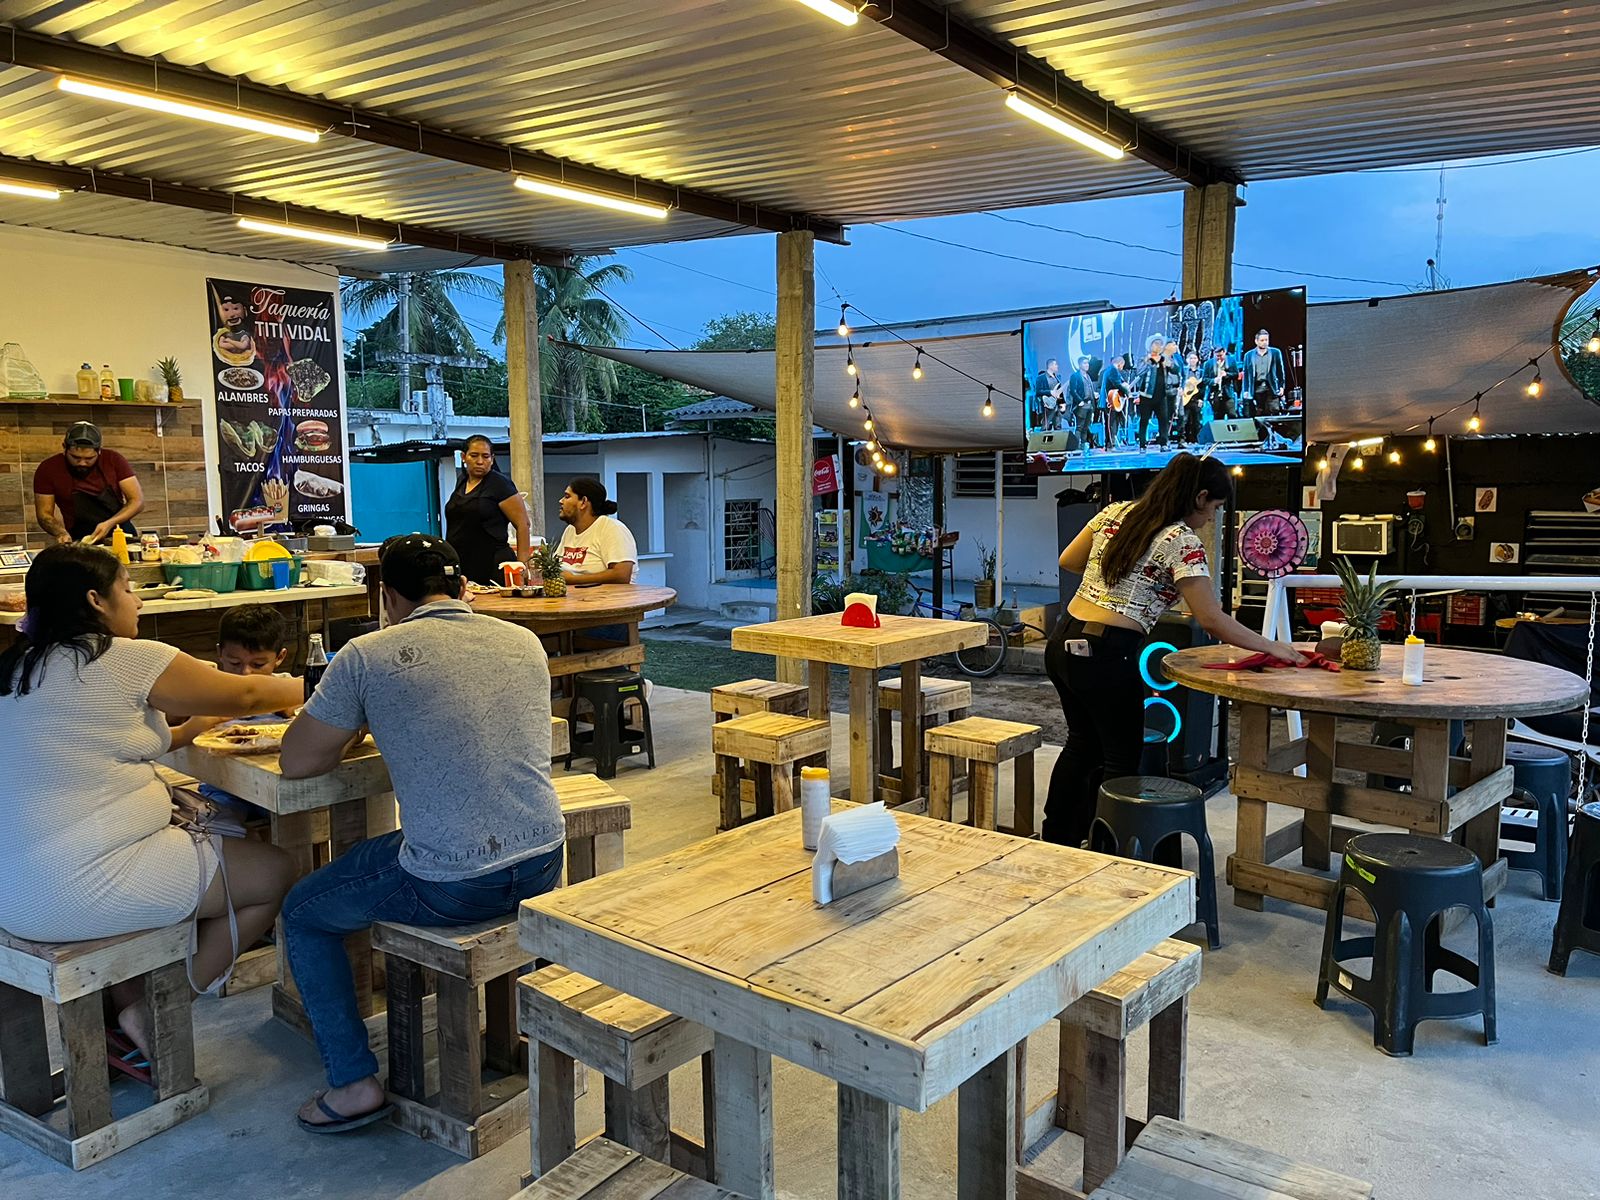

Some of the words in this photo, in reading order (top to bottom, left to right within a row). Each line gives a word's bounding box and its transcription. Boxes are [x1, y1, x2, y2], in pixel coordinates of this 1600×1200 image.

[250, 287, 330, 323] Taquería
[254, 320, 283, 338] TITI
[287, 324, 331, 342] VIDAL
[1083, 315, 1101, 343] EL
[218, 391, 269, 403] ALAMBRES
[268, 407, 291, 417] PAPAS
[292, 408, 338, 418] PREPARADAS
[282, 455, 342, 464] HAMBURGUESAS
[234, 462, 265, 473] TACOS
[297, 503, 330, 513] GRINGAS
